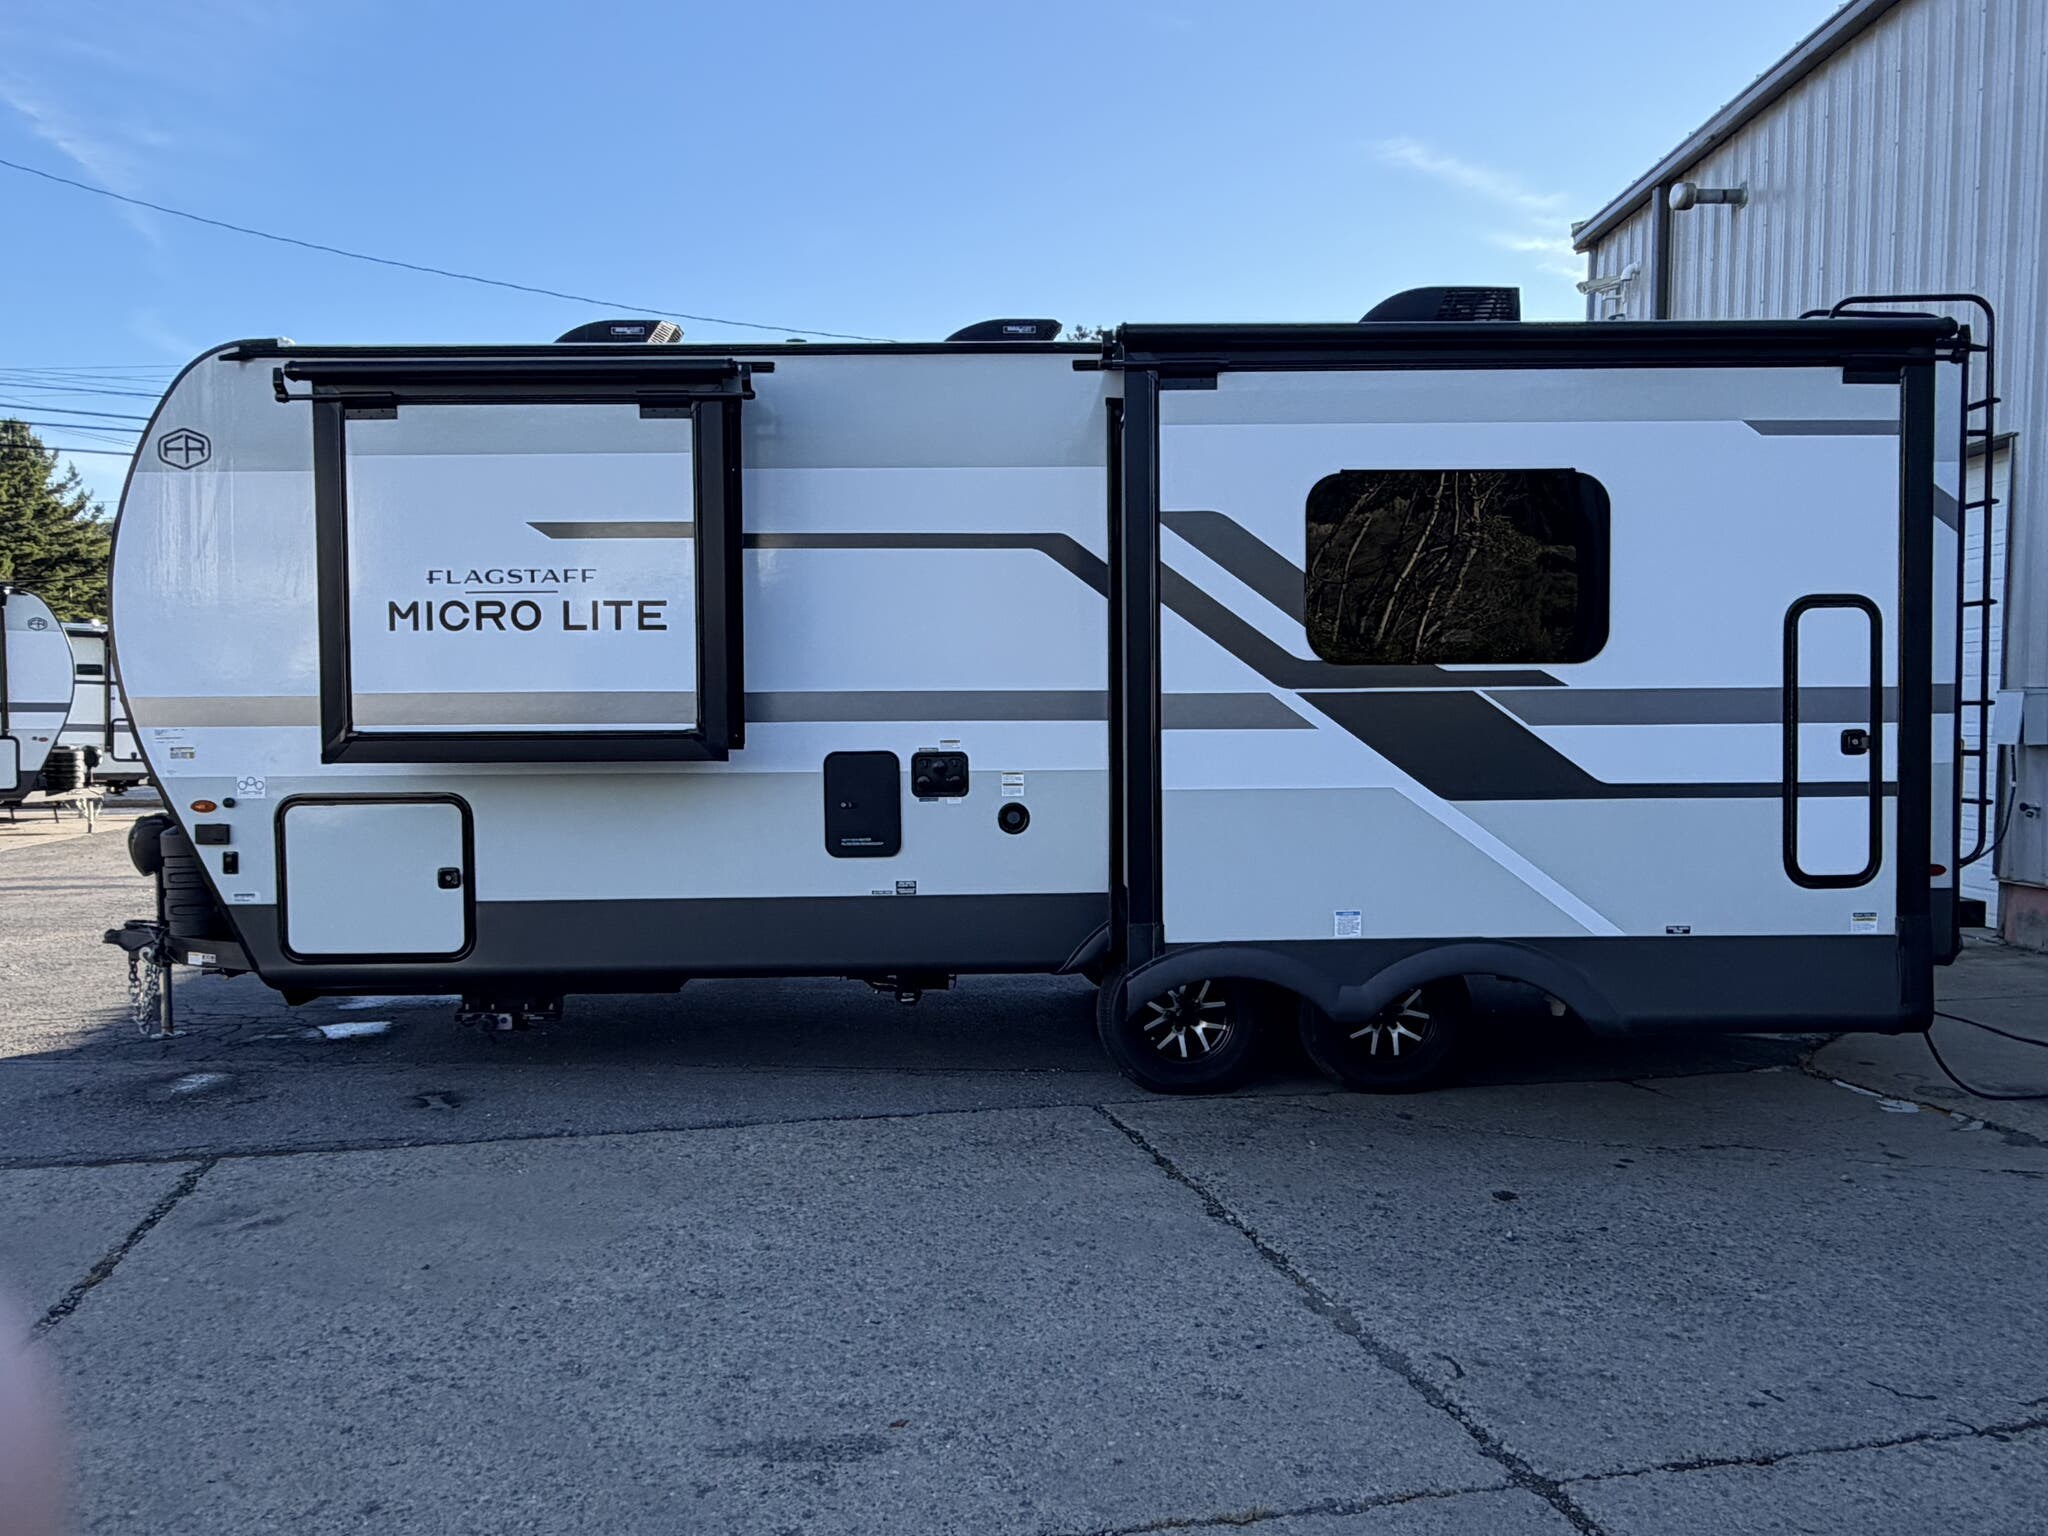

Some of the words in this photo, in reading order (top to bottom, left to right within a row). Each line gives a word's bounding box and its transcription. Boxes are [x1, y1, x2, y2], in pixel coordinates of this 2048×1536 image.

[426, 568, 597, 585] FLAGSTAFF
[388, 599, 542, 632] MICRO
[562, 599, 668, 631] LITE
